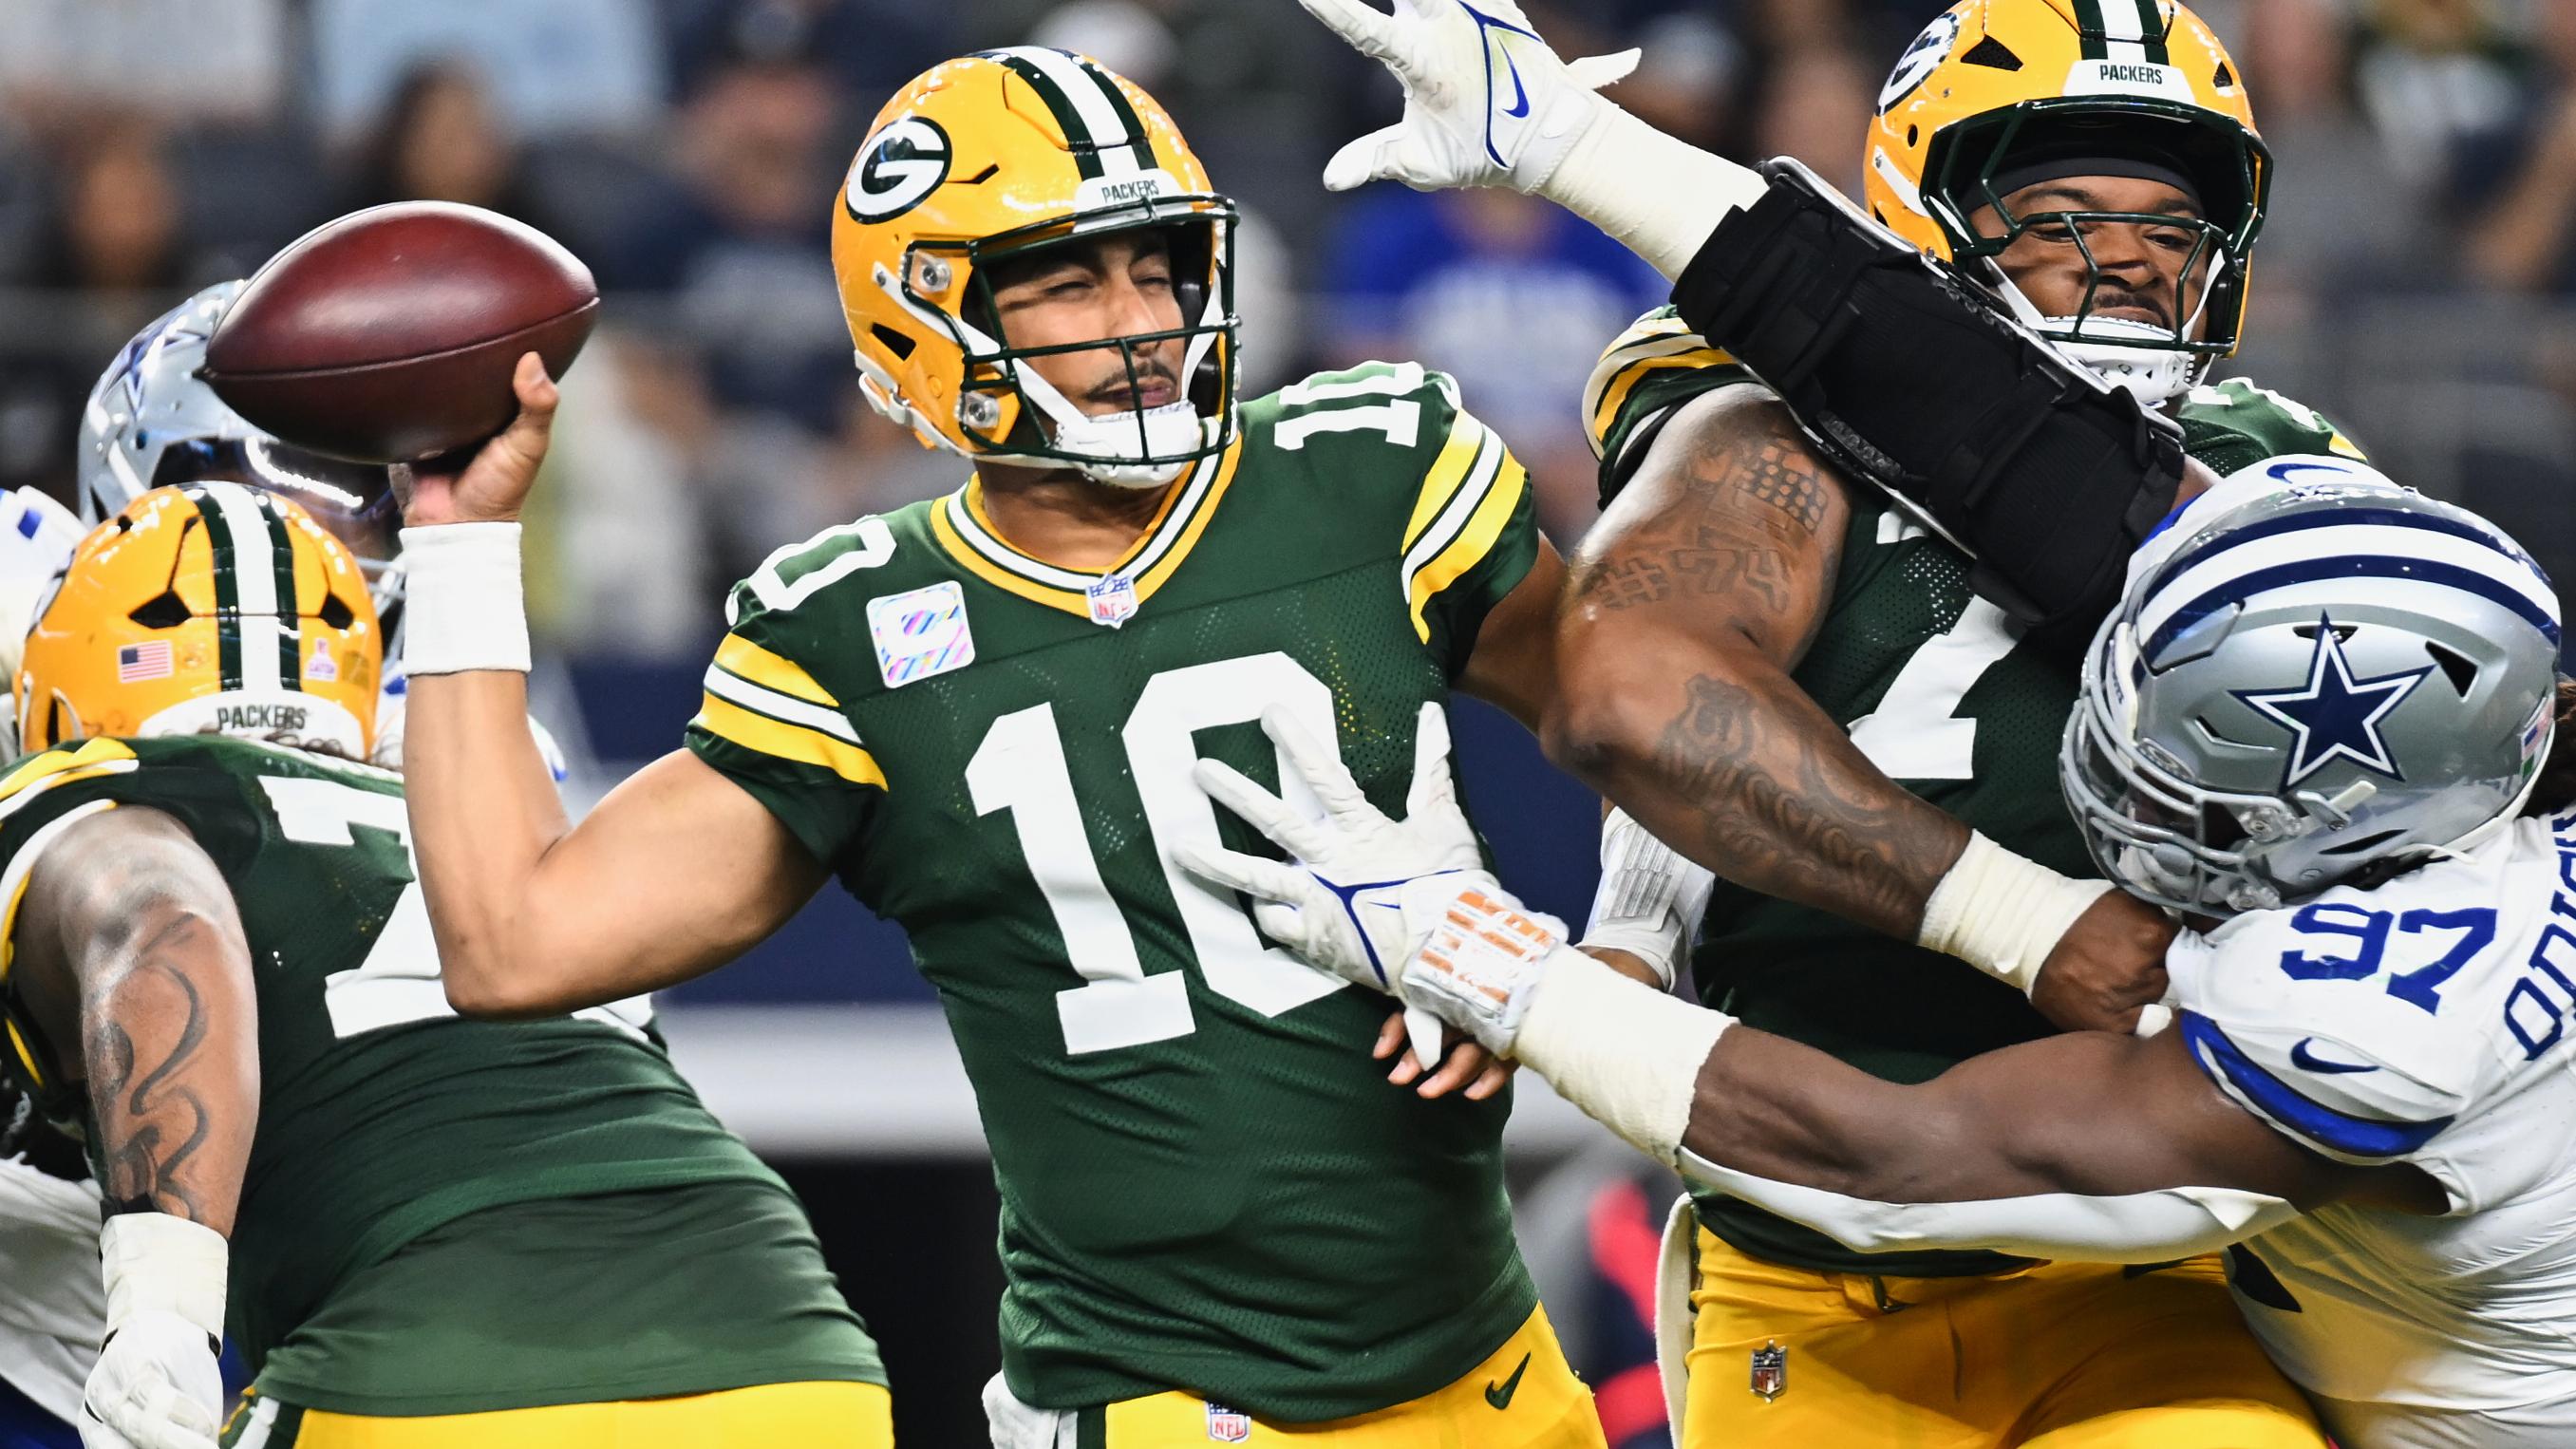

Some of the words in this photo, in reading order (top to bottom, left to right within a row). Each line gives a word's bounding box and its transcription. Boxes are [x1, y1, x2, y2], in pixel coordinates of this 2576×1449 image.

[2099, 64, 2163, 85] PACKERS
[845, 116, 952, 225] G
[1101, 179, 1159, 203] PACKERS
[216, 705, 307, 730] PACKERS
[965, 650, 1351, 1056] 10
[2280, 903, 2498, 1017] 97
[1214, 1421, 1245, 1439] NFL
